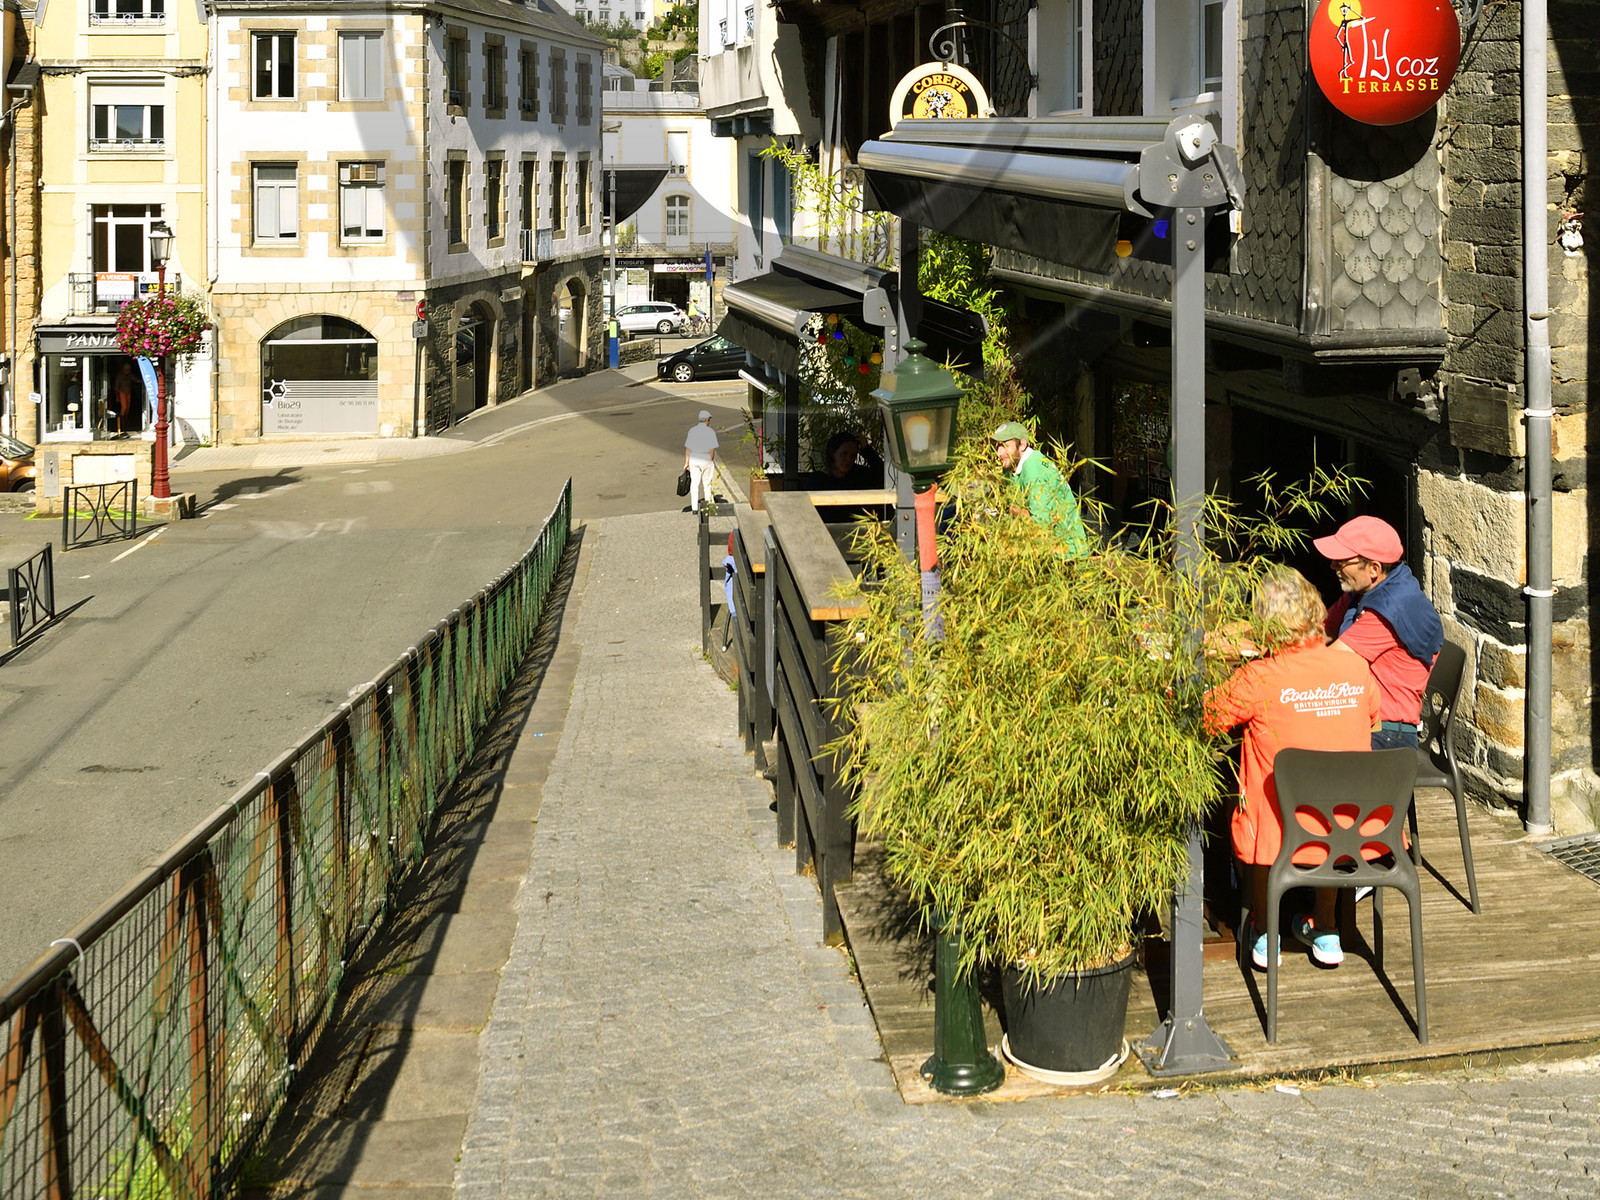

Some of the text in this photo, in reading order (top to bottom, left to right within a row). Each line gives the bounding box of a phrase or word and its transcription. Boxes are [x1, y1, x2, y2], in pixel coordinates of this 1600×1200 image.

[912, 74, 969, 94] COREFF
[1339, 77, 1440, 94] TERRASSE
[277, 401, 301, 409] Bio29
[1280, 683, 1336, 703] Coastal
